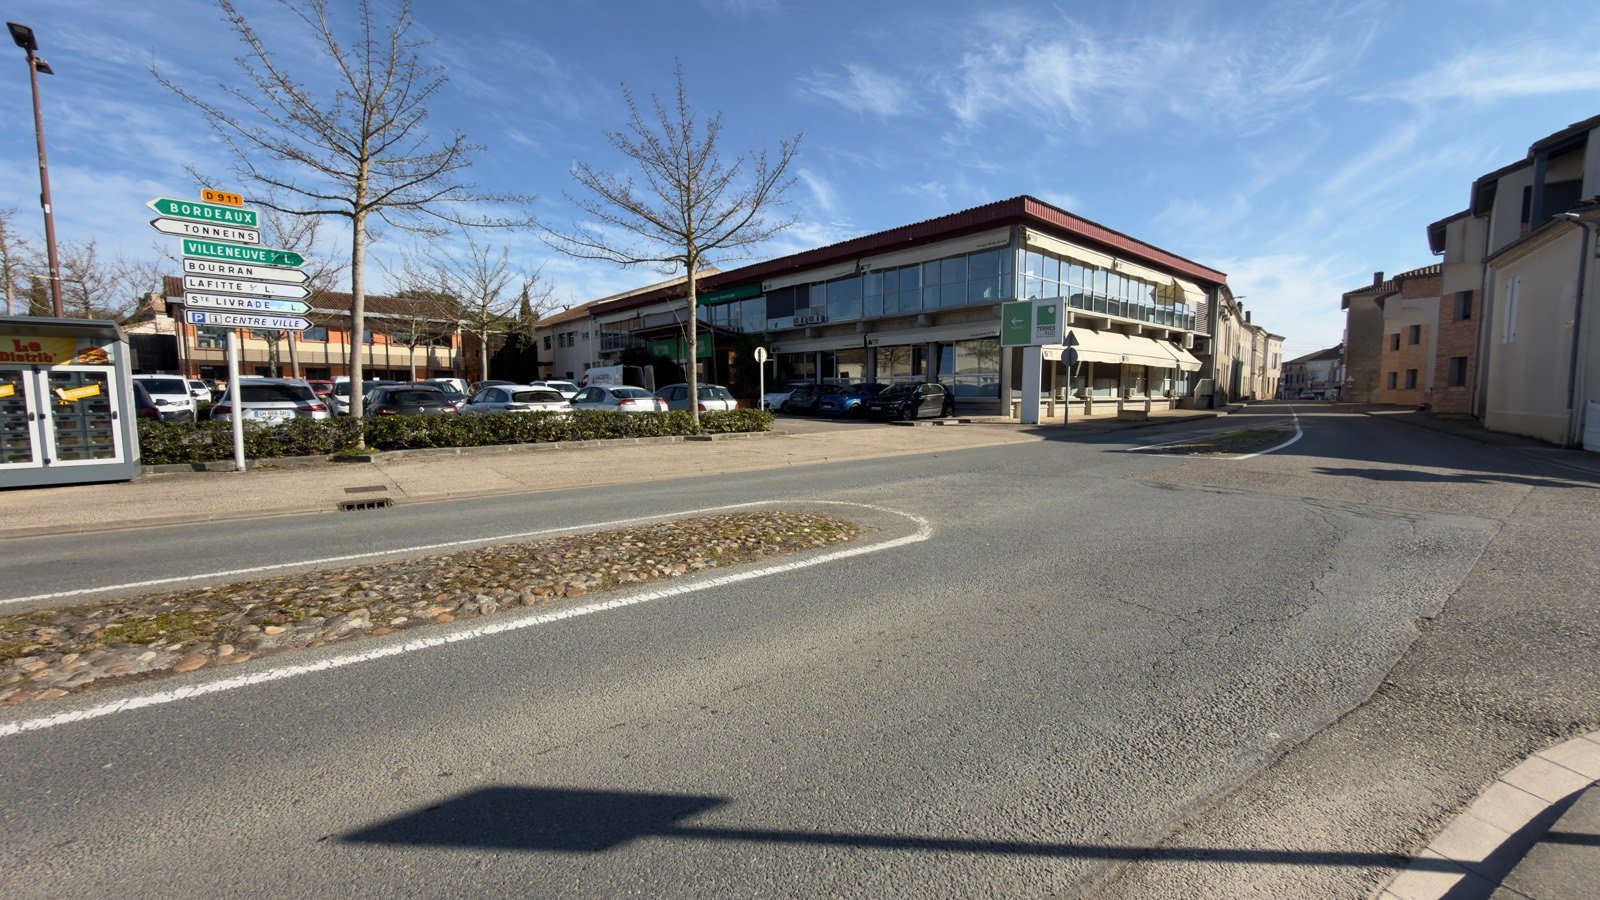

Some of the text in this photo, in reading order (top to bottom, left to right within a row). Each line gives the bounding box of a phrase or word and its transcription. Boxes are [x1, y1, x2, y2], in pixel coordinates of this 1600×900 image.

[206, 191, 239, 203] D 911
[170, 203, 252, 223] BORDEAUX
[184, 224, 254, 240] TONNEINS
[188, 243, 266, 260] VILLENEUVE
[188, 262, 254, 276] BOURRAN
[189, 279, 244, 292] LAFITTE
[215, 296, 271, 310] LIVRADE
[194, 313, 205, 324] P
[224, 315, 268, 328] CENTRE
[272, 318, 301, 329] VILLE
[12, 338, 42, 353] Le
